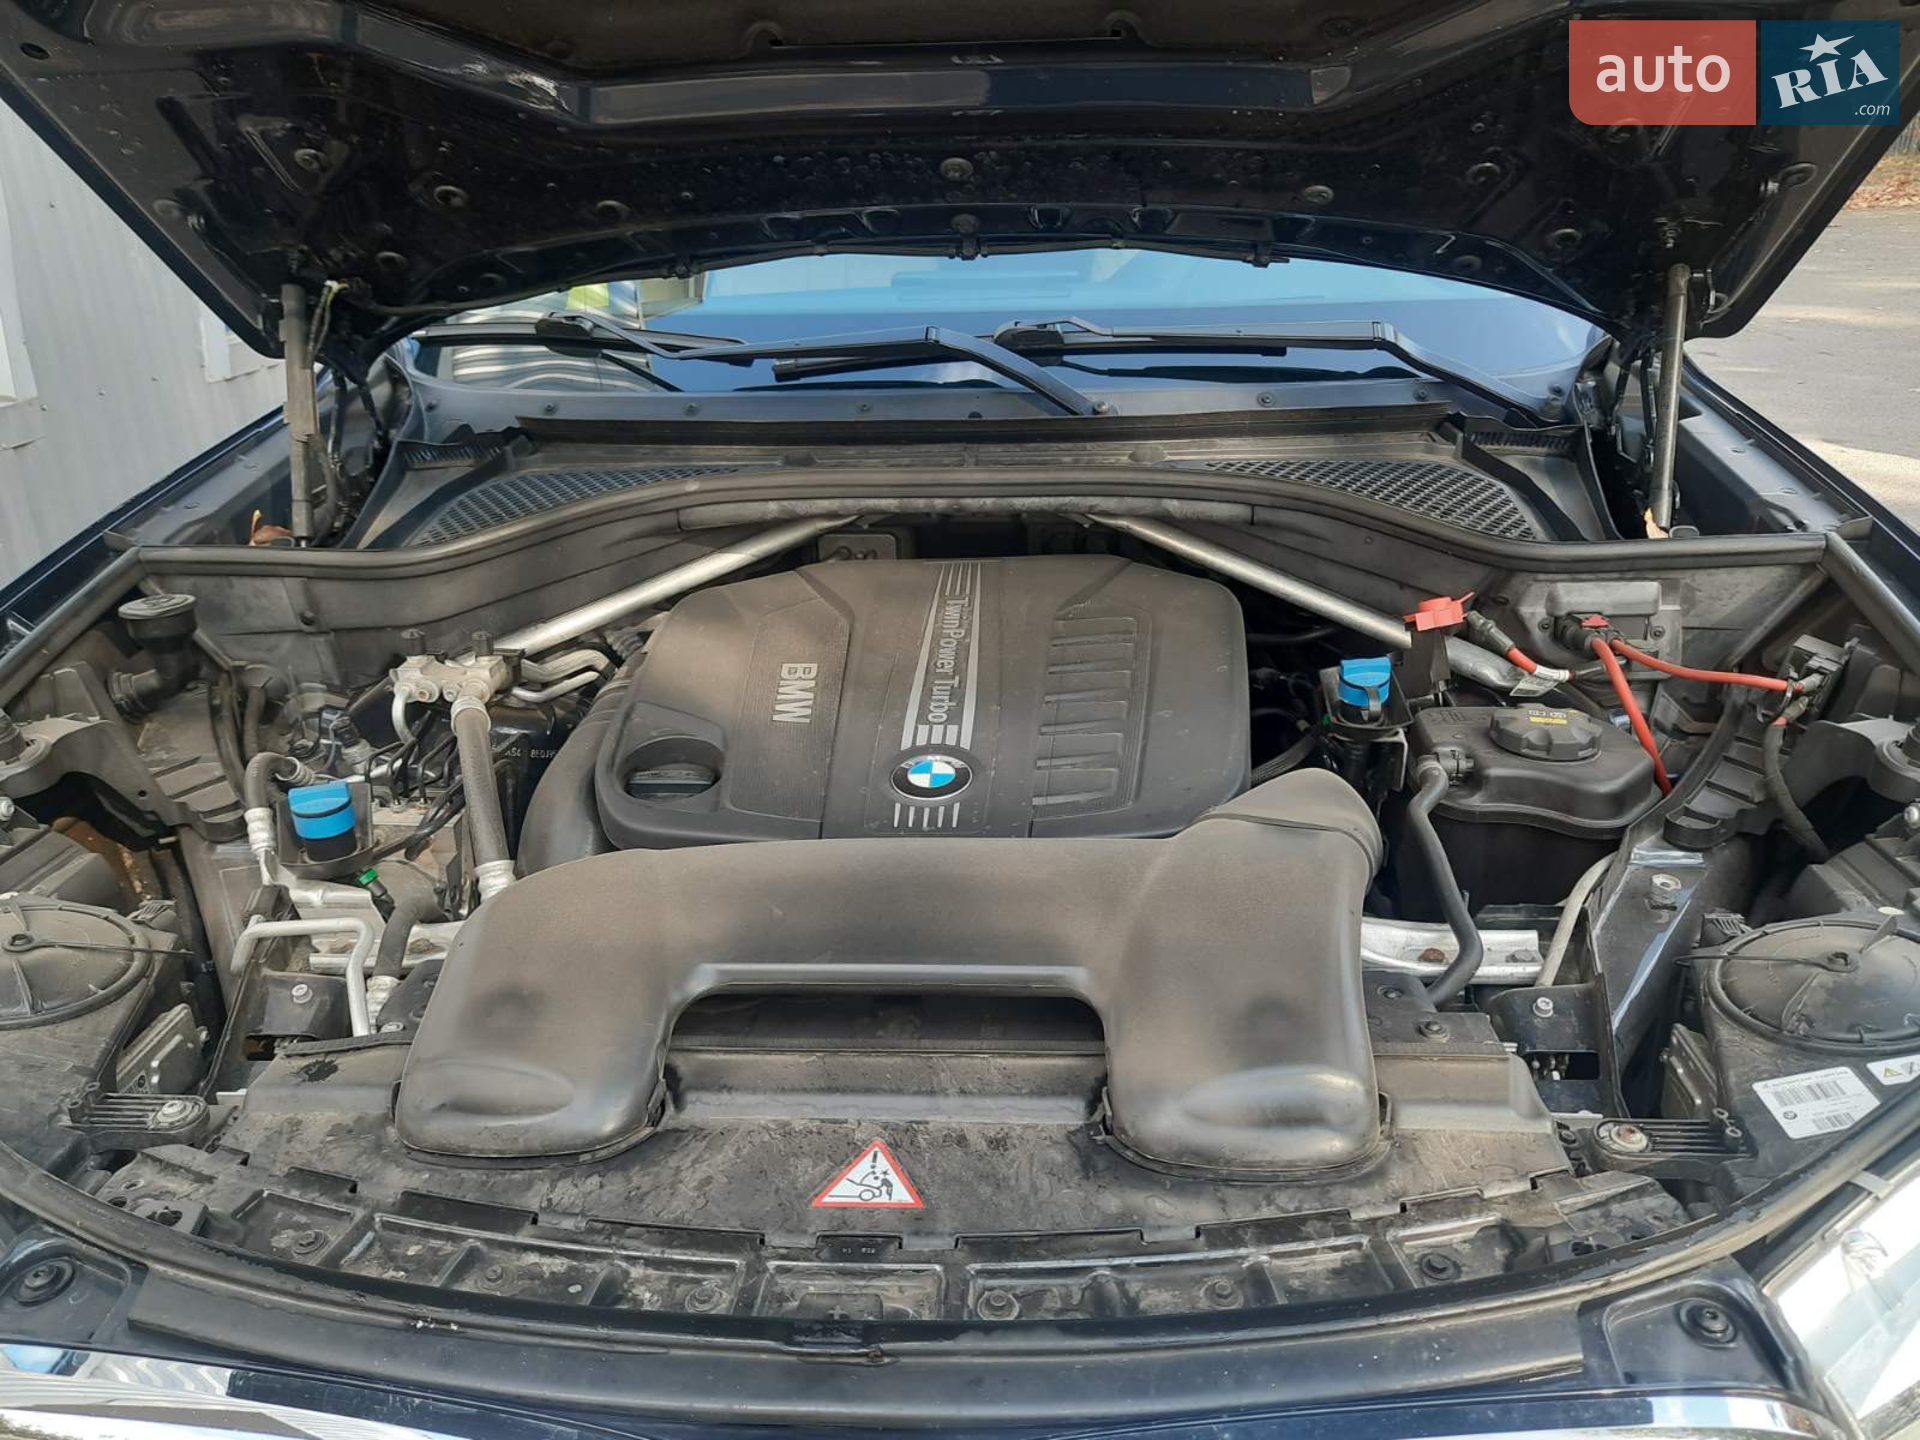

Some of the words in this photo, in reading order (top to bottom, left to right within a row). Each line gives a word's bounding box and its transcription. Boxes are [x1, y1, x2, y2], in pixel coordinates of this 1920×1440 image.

[935, 597, 969, 675] TwinPower
[772, 663, 818, 724] BMW
[928, 675, 959, 723] Turbo
